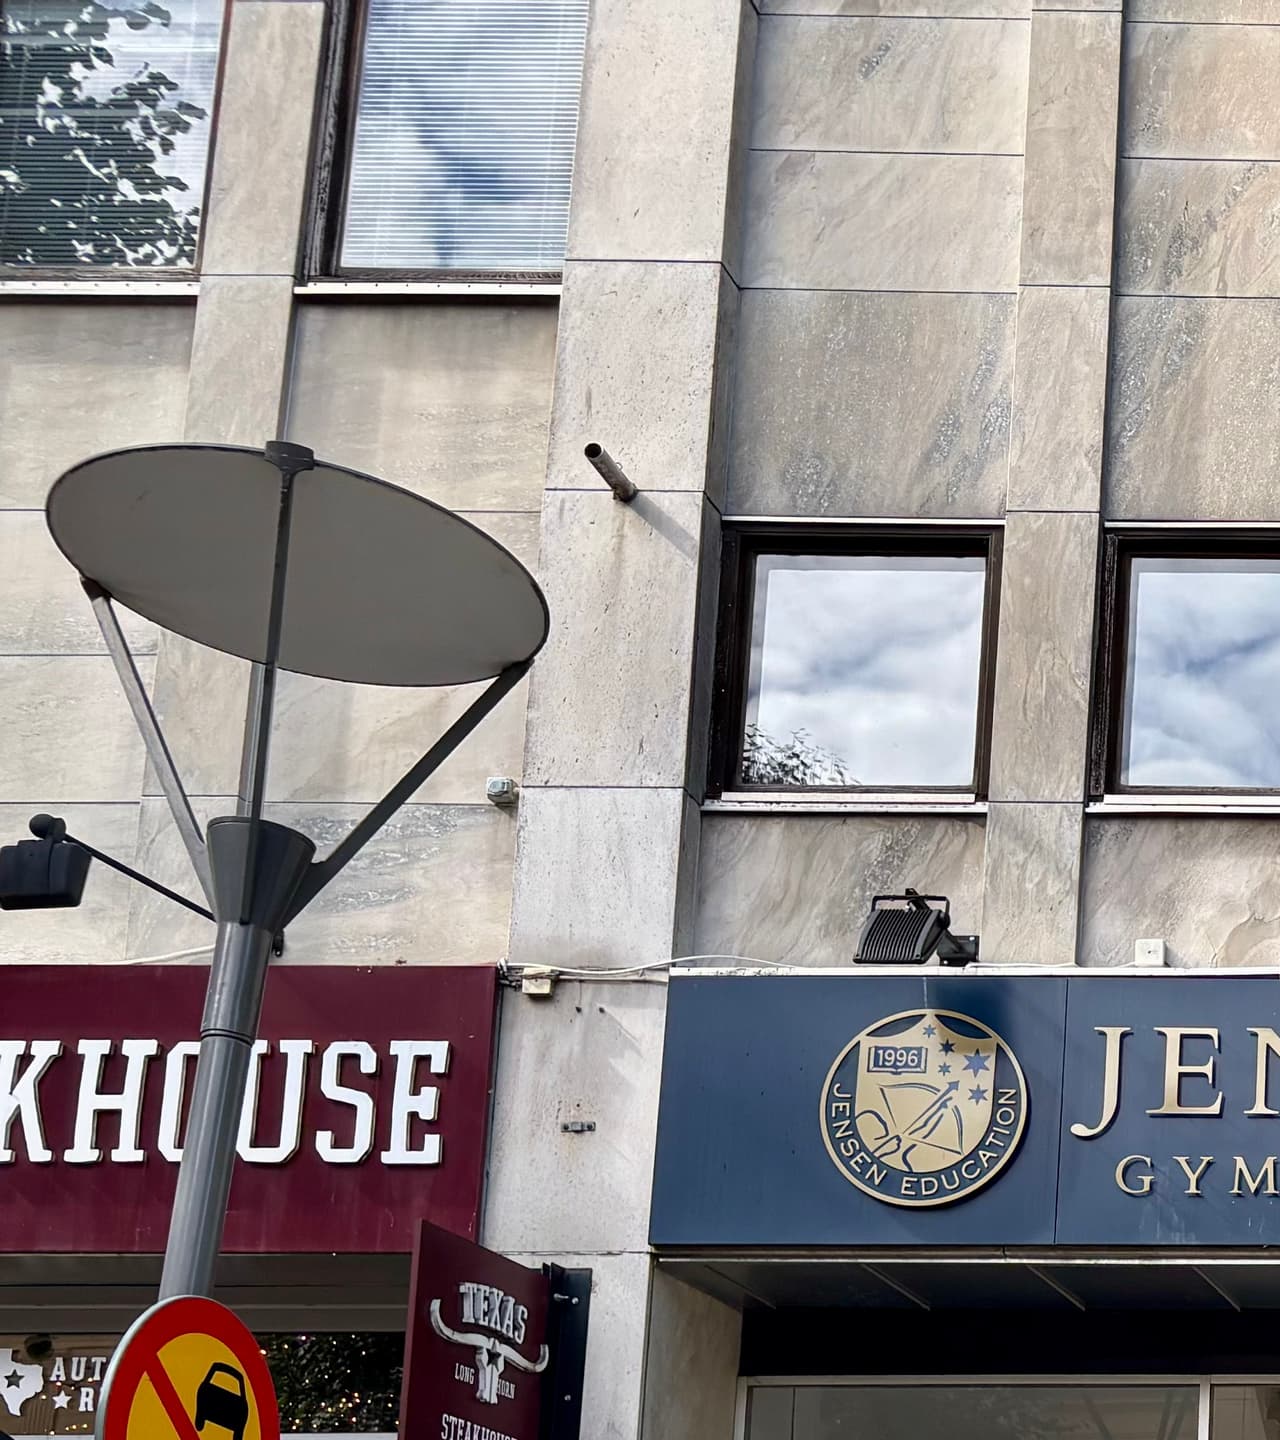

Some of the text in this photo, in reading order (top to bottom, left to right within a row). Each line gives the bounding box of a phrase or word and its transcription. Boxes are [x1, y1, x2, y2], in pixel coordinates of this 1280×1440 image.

[877, 1049, 919, 1067] 1996
[831, 1083, 1017, 1195] JENSEN EDUCATION
[459, 1281, 528, 1345] TEXAS
[454, 1362, 475, 1385] LONG
